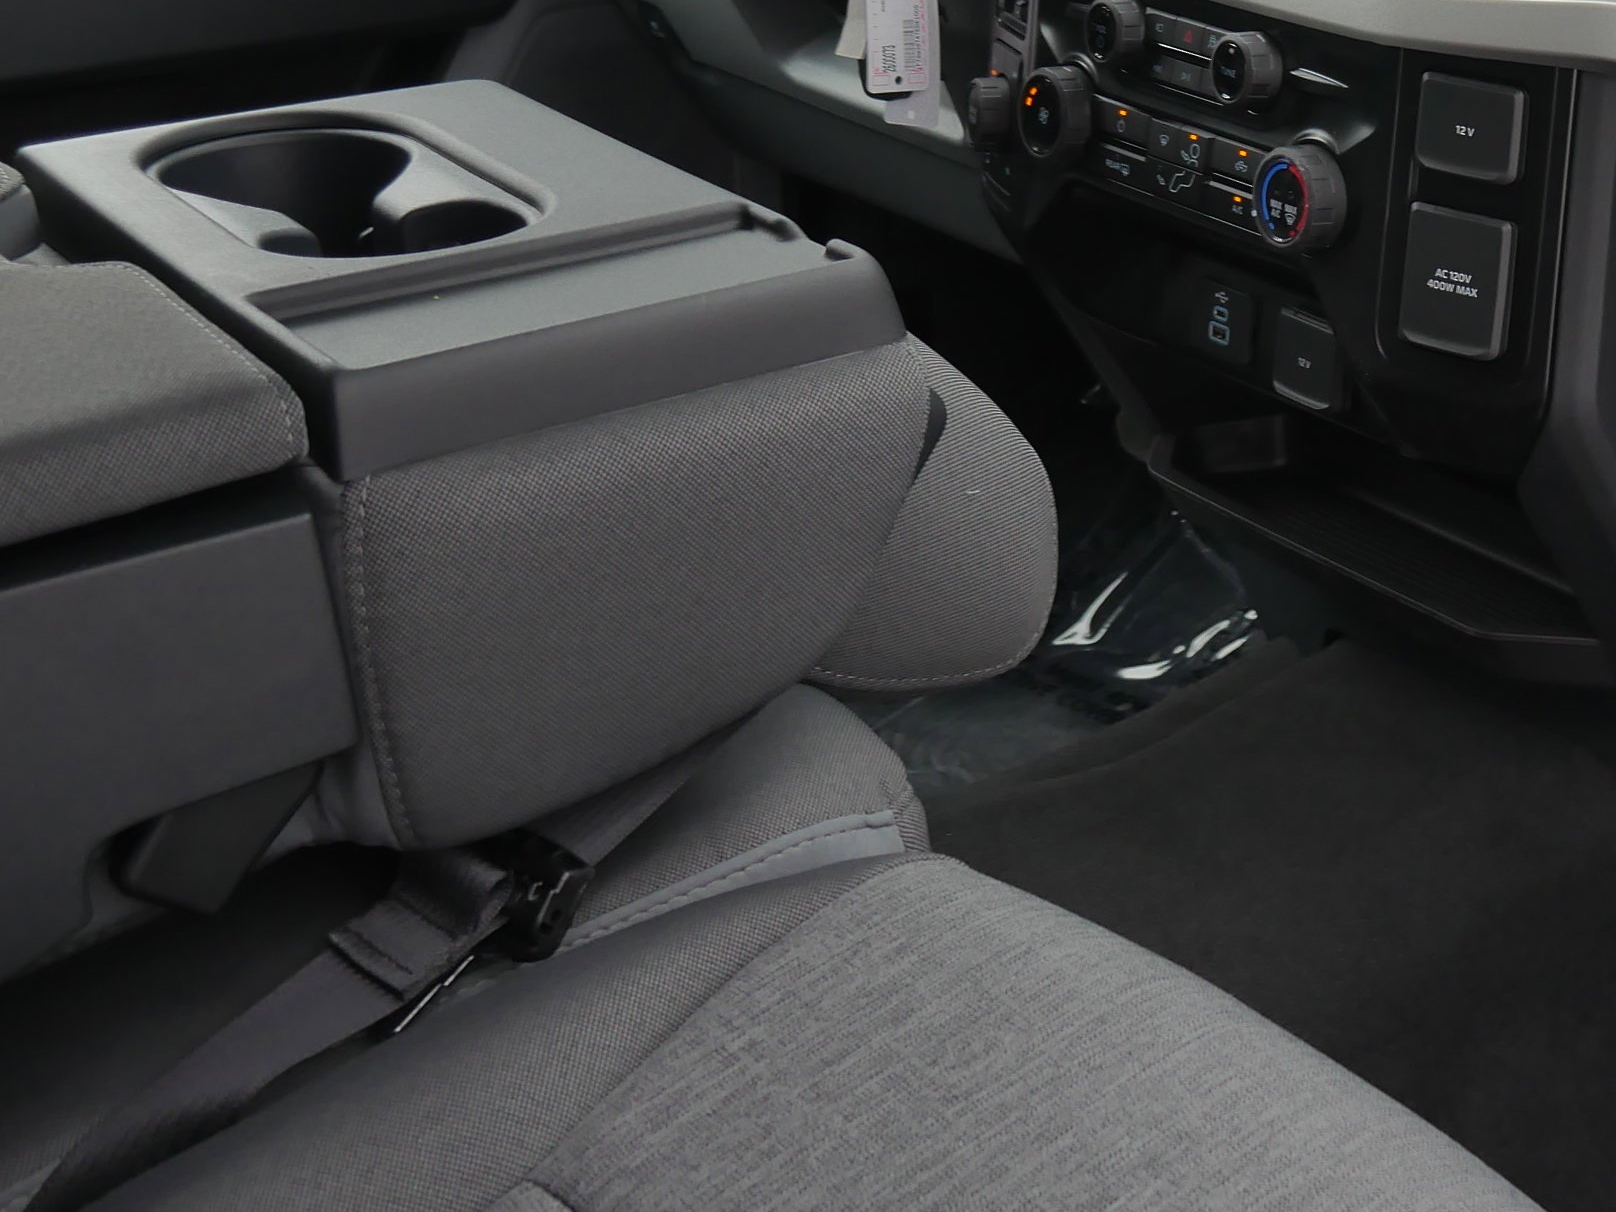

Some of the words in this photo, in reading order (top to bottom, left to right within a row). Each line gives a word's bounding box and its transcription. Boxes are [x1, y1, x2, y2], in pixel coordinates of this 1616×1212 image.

[1435, 268, 1448, 279] AC
[1449, 271, 1472, 284] 120V
[1427, 279, 1455, 293] 400W
[1456, 285, 1478, 298] MAX
